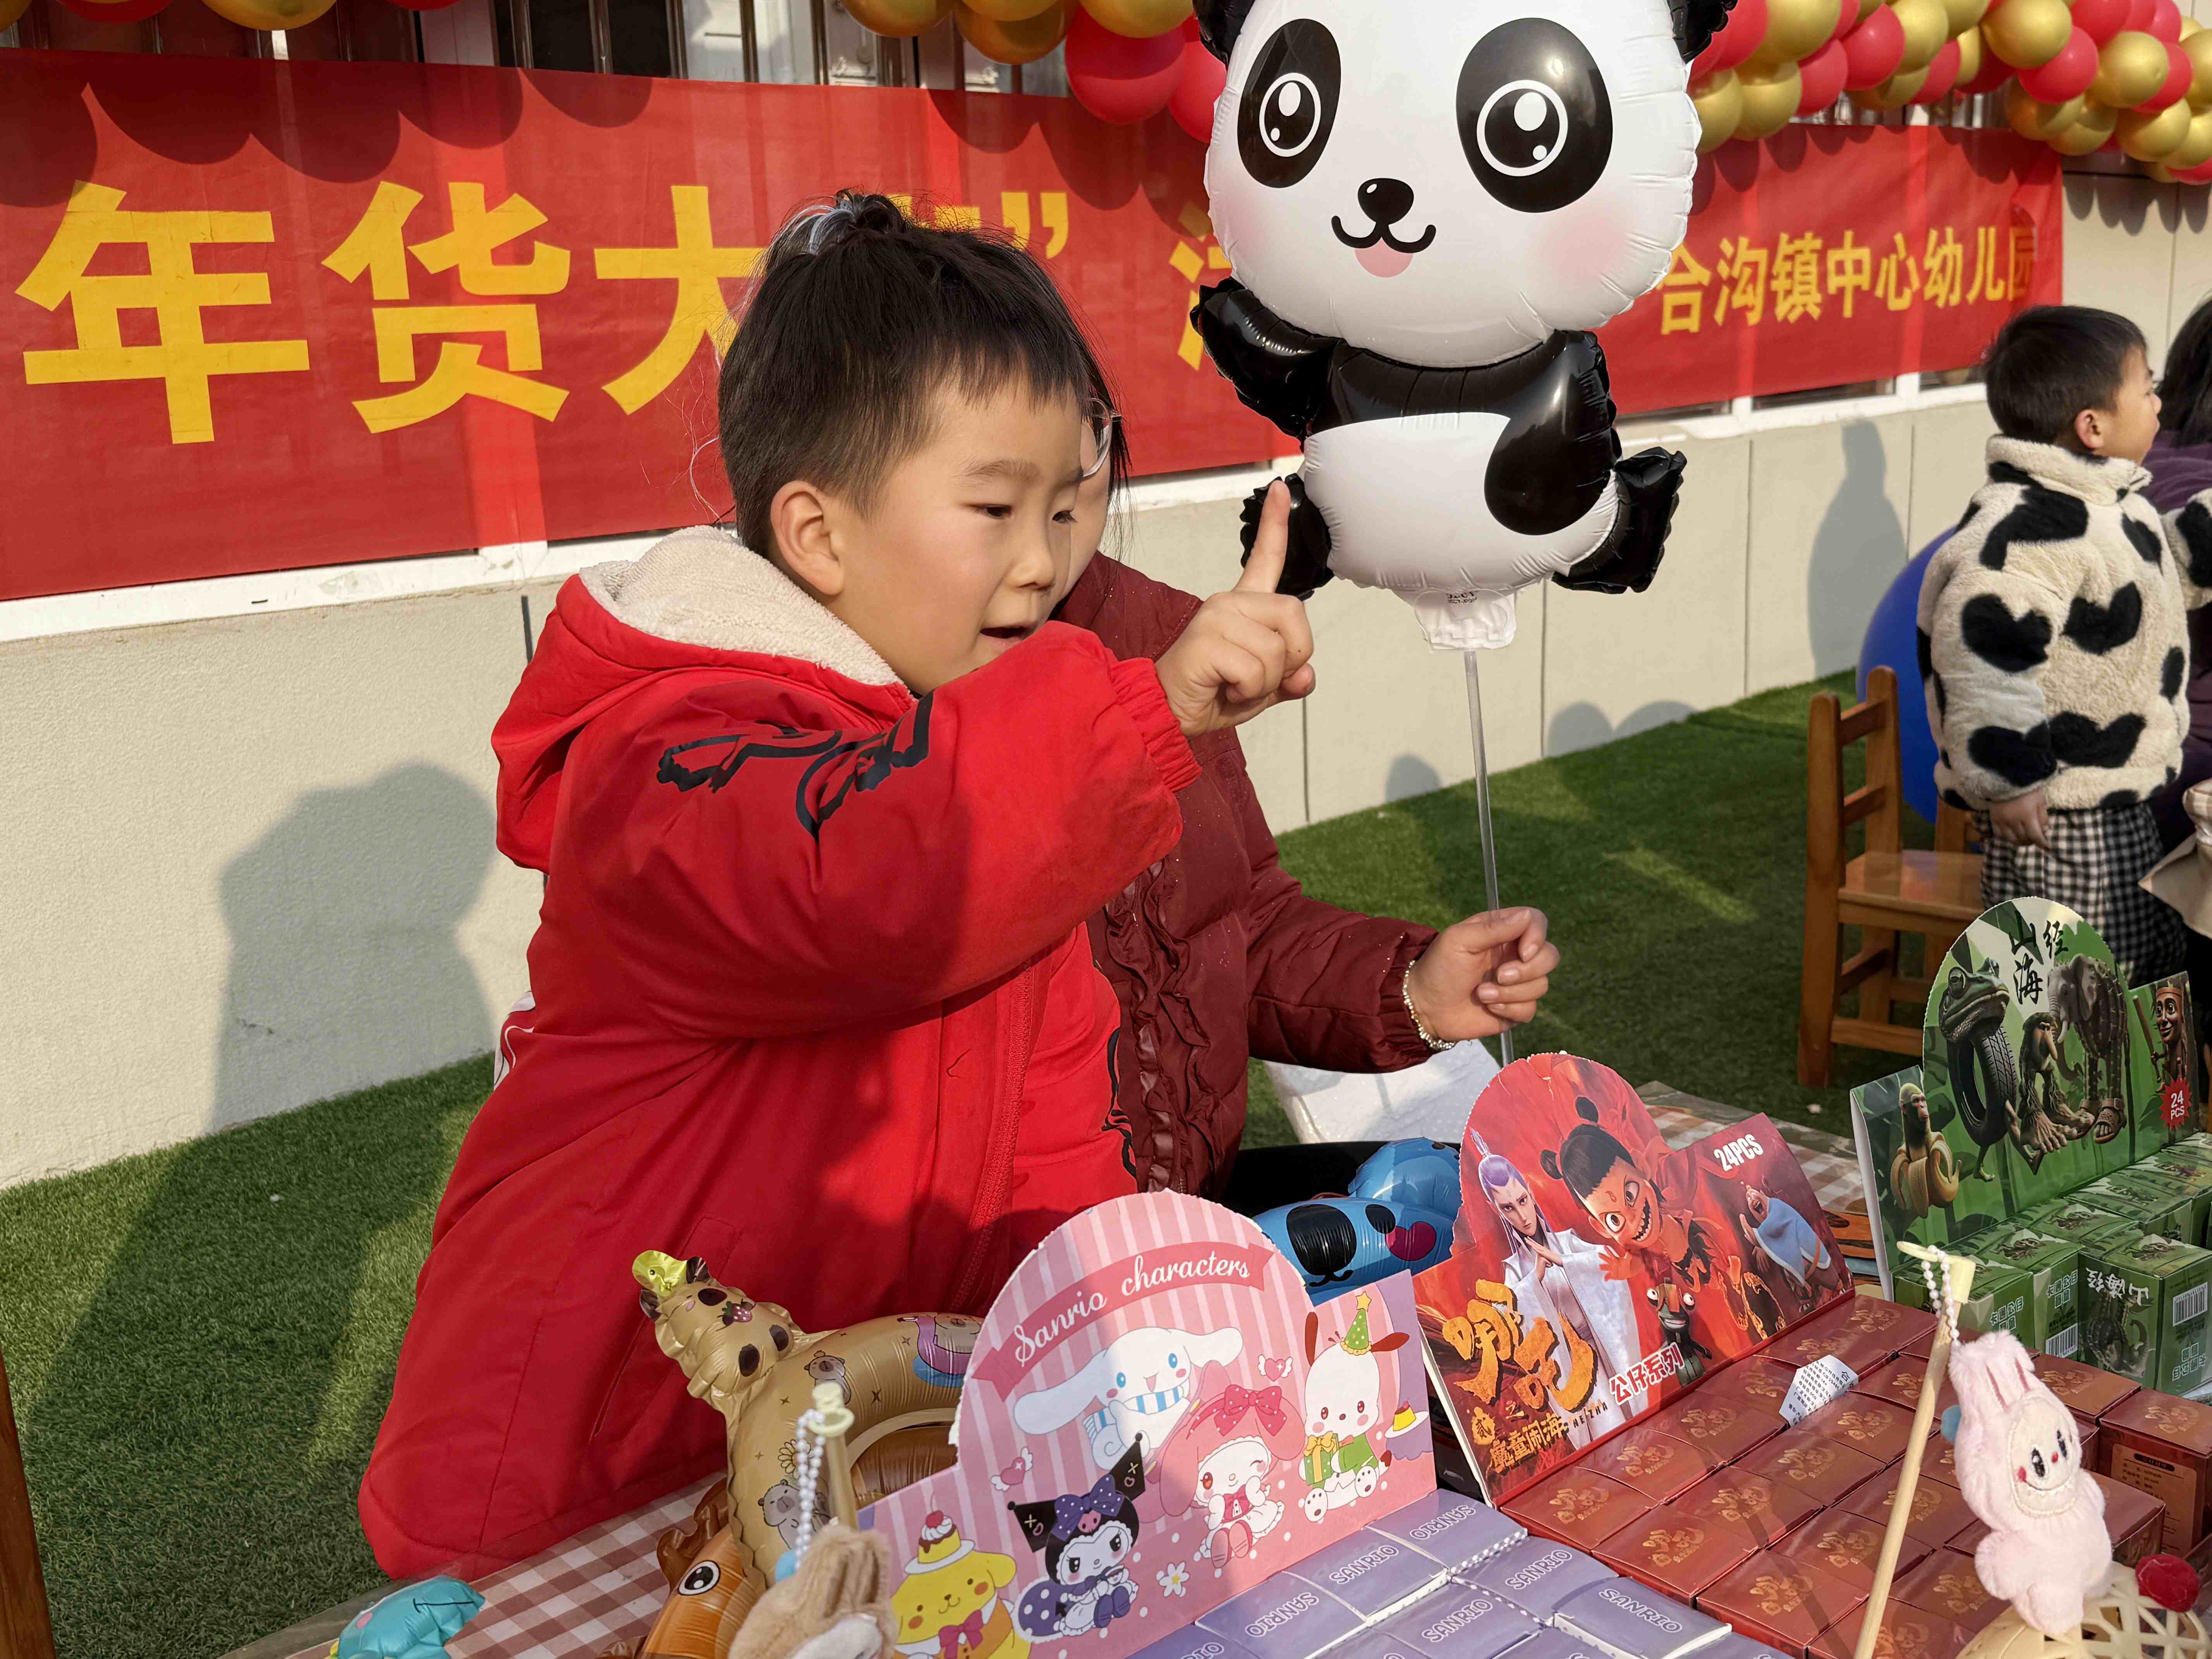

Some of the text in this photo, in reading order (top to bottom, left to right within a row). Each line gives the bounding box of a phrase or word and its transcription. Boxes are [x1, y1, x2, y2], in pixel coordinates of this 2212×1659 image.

[15, 178, 1068, 443] 年货大”
[2170, 1105, 2185, 1120] PCS
[2171, 1090, 2184, 1108] 24
[1714, 1133, 1764, 1172] 24PCS
[1015, 1251, 1251, 1367] Sanrio characters
[1609, 1341, 1685, 1406] 公仔系列
[1410, 1505, 1476, 1540] SANRIO
[1329, 1545, 1399, 1585] SANRIO
[1505, 1549, 1573, 1590] SANRIO
[1245, 1592, 1319, 1638] SANRIO
[1421, 1599, 1493, 1643] SANRIO
[1599, 1589, 1683, 1633] SANRIO
